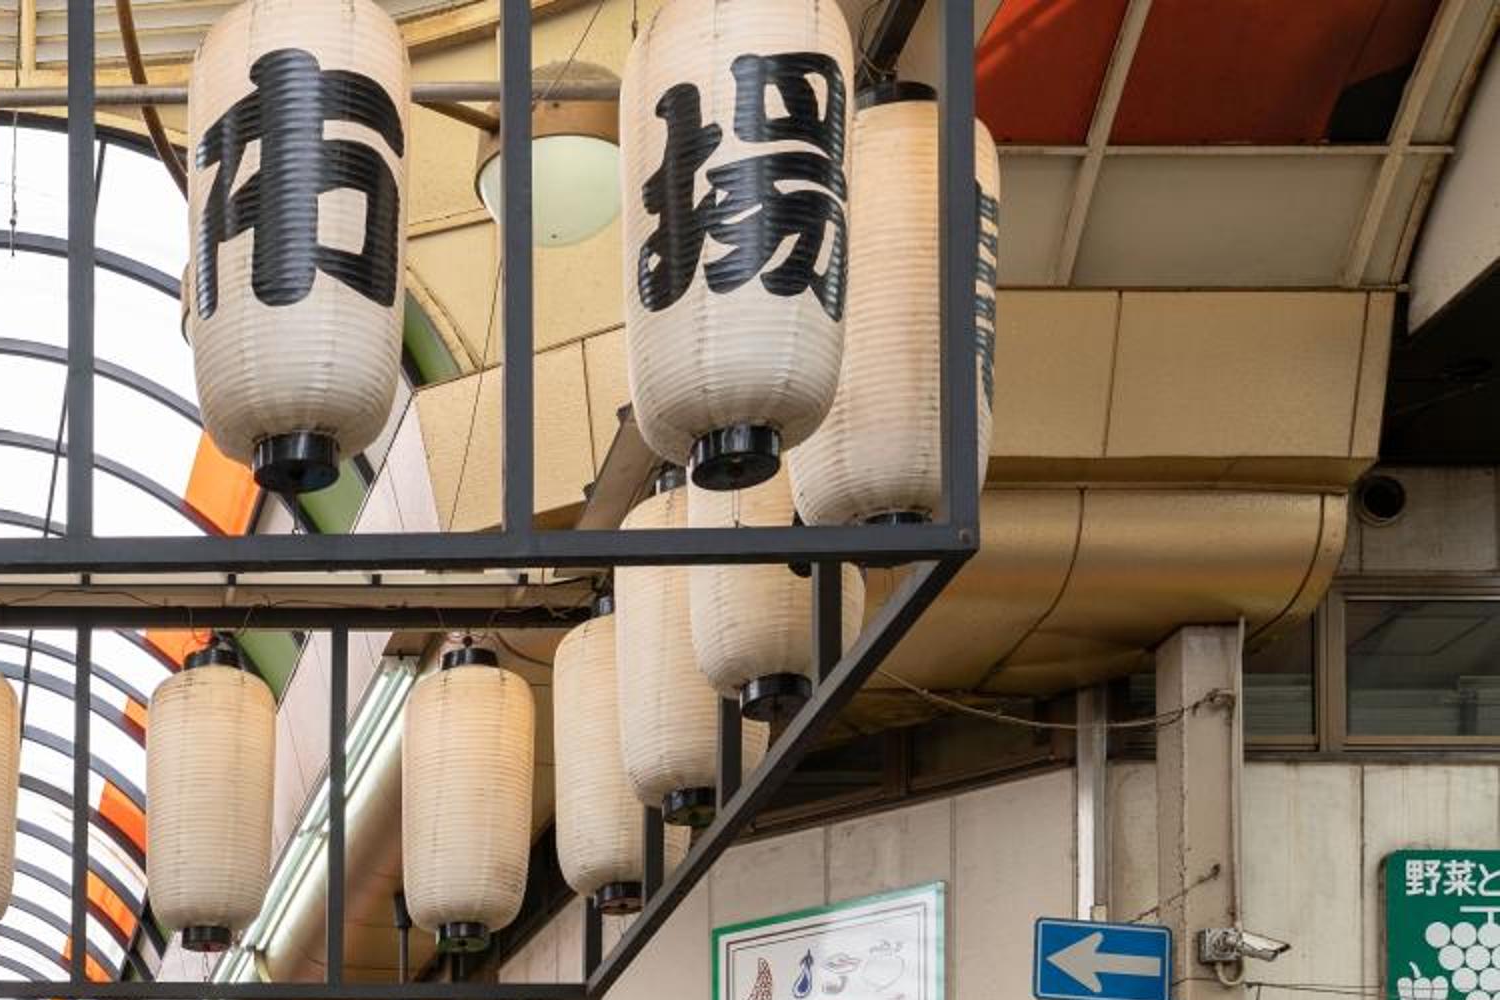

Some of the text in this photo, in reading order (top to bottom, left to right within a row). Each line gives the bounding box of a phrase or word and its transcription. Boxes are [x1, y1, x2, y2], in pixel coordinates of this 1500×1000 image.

[196, 48, 403, 320] 市
[638, 52, 847, 322] 場
[1405, 859, 1500, 897] 野菜と
